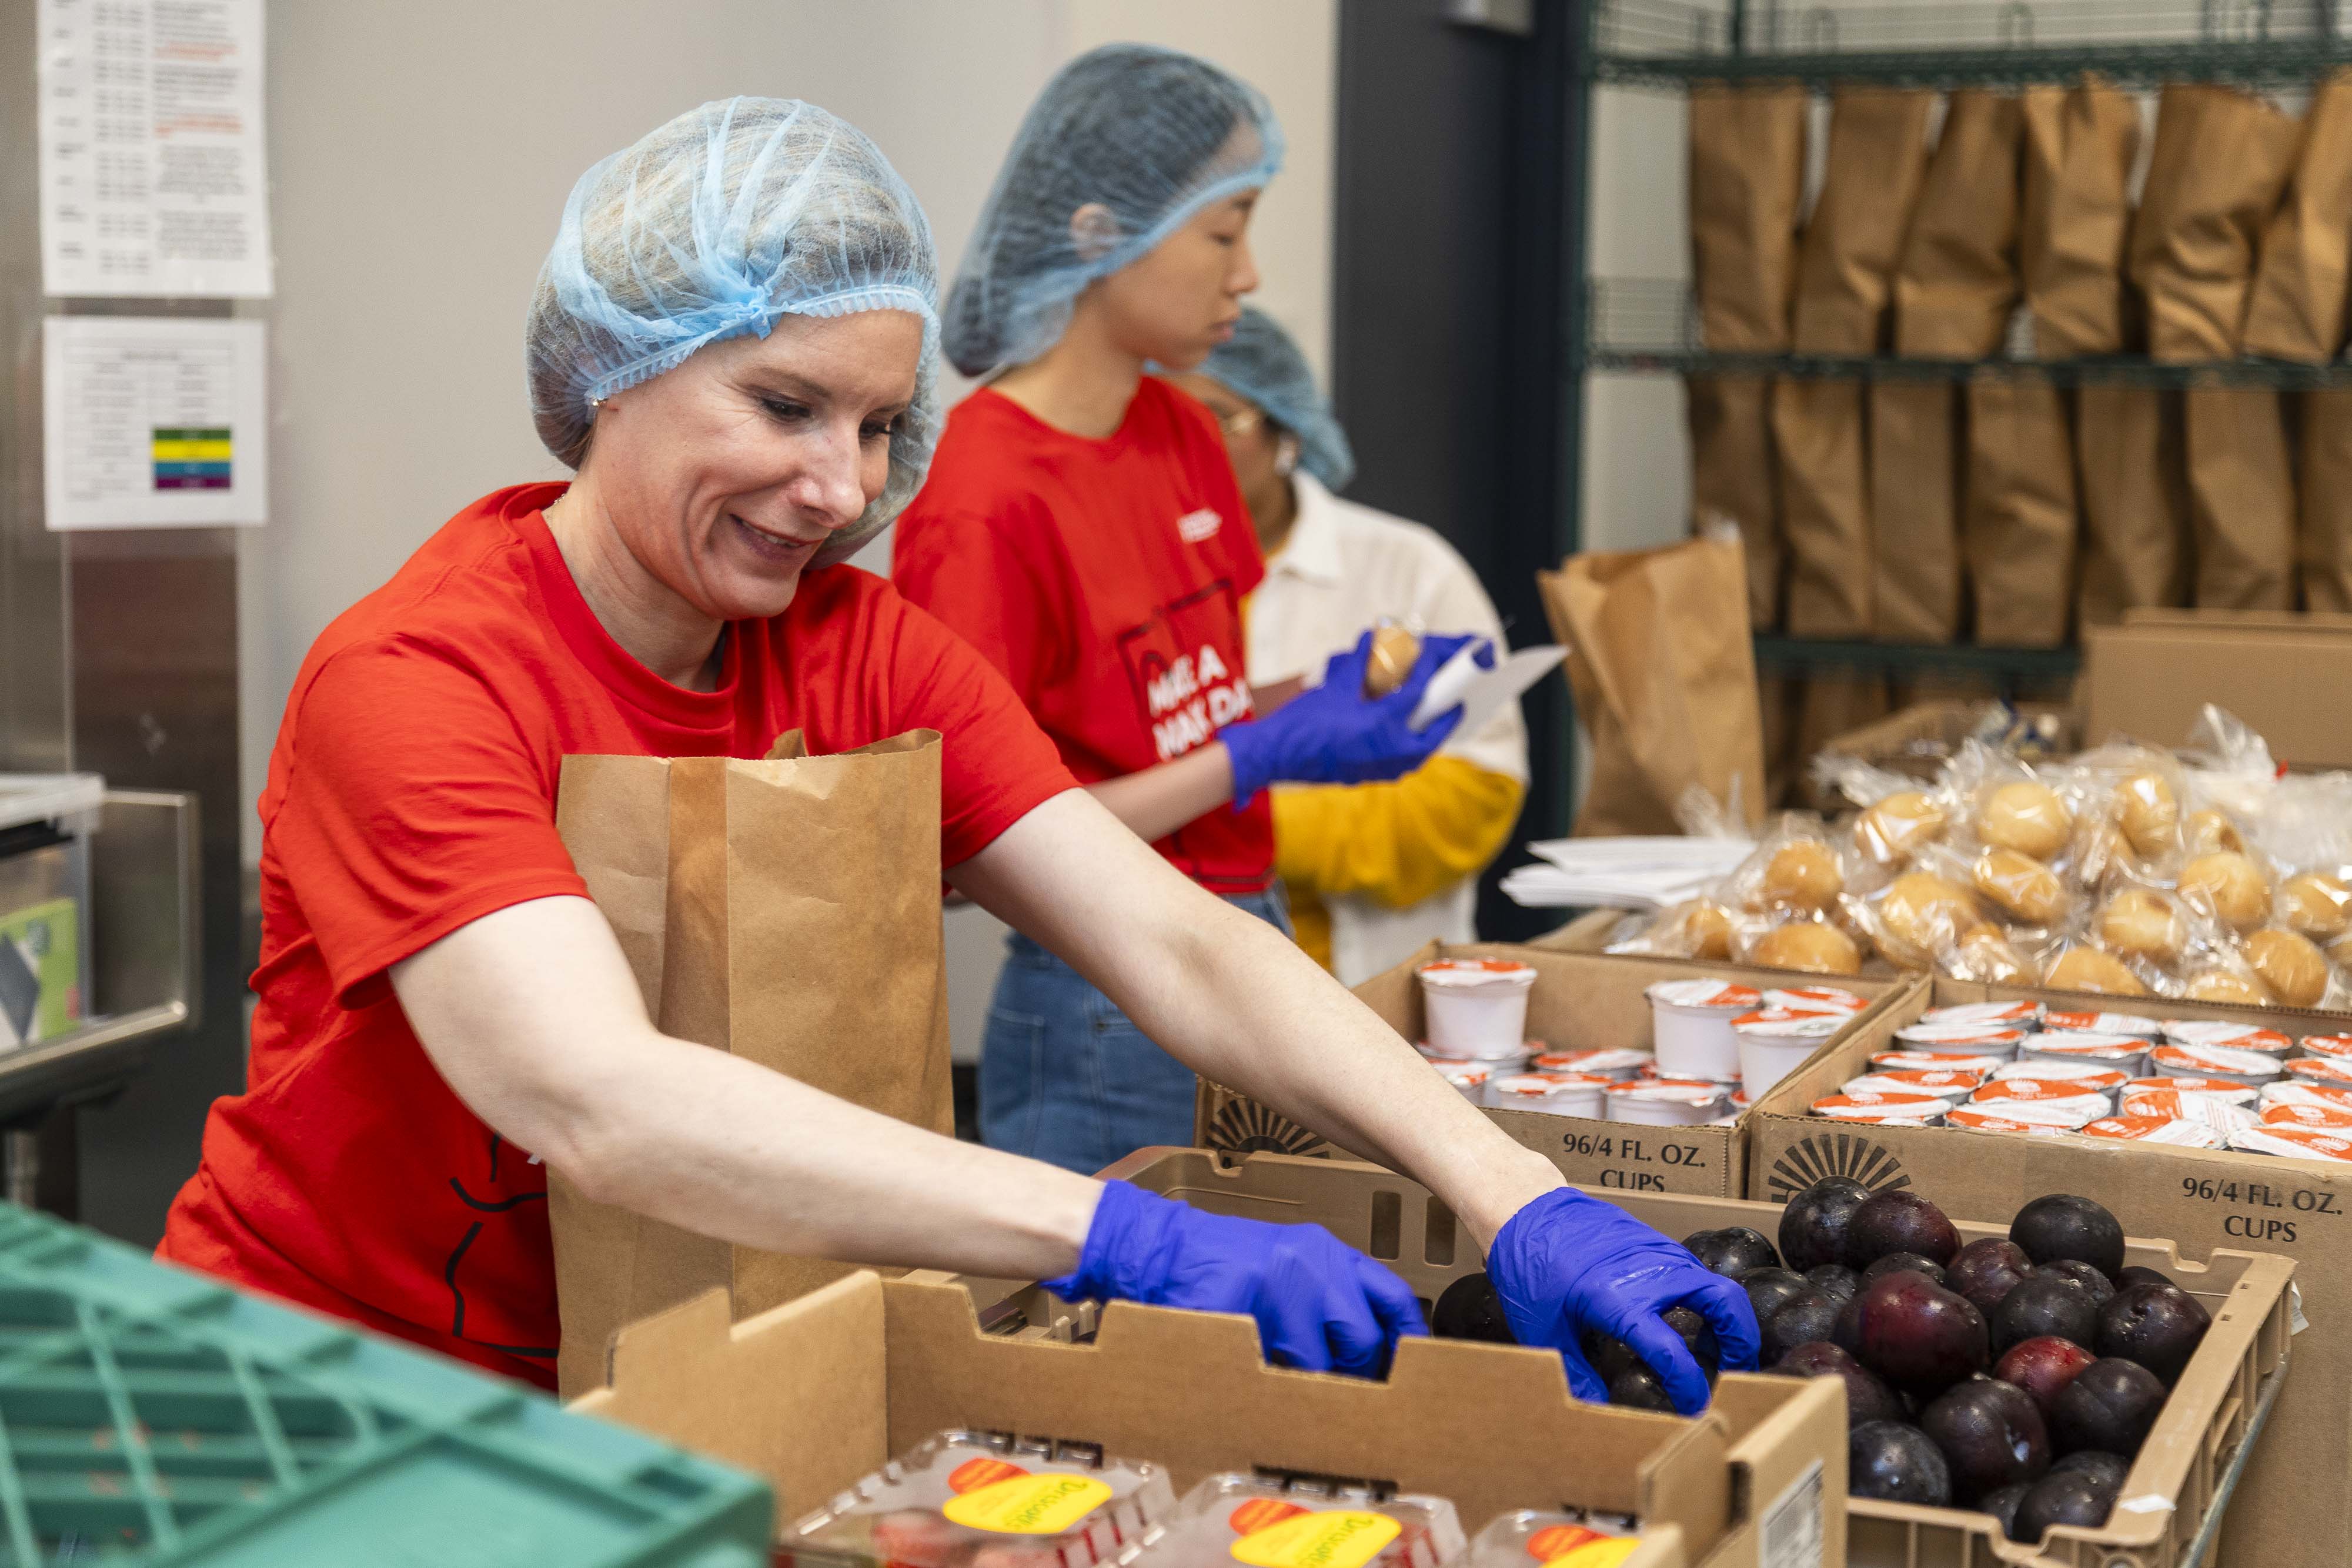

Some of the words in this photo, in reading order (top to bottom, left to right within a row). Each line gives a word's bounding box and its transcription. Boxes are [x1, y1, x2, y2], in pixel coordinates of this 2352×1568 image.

[1198, 644, 1228, 687] A
[1563, 1134, 1613, 1158] 96/4
[1621, 1139, 1652, 1162] FL.
[1661, 1144, 1706, 1168] OZ.
[1600, 1169, 1665, 1192] CUPS
[2182, 1177, 2239, 1202] 96/4
[2248, 1183, 2283, 1208] FL.
[2293, 1189, 2343, 1215] OZ.
[2224, 1215, 2297, 1243] CUPS
